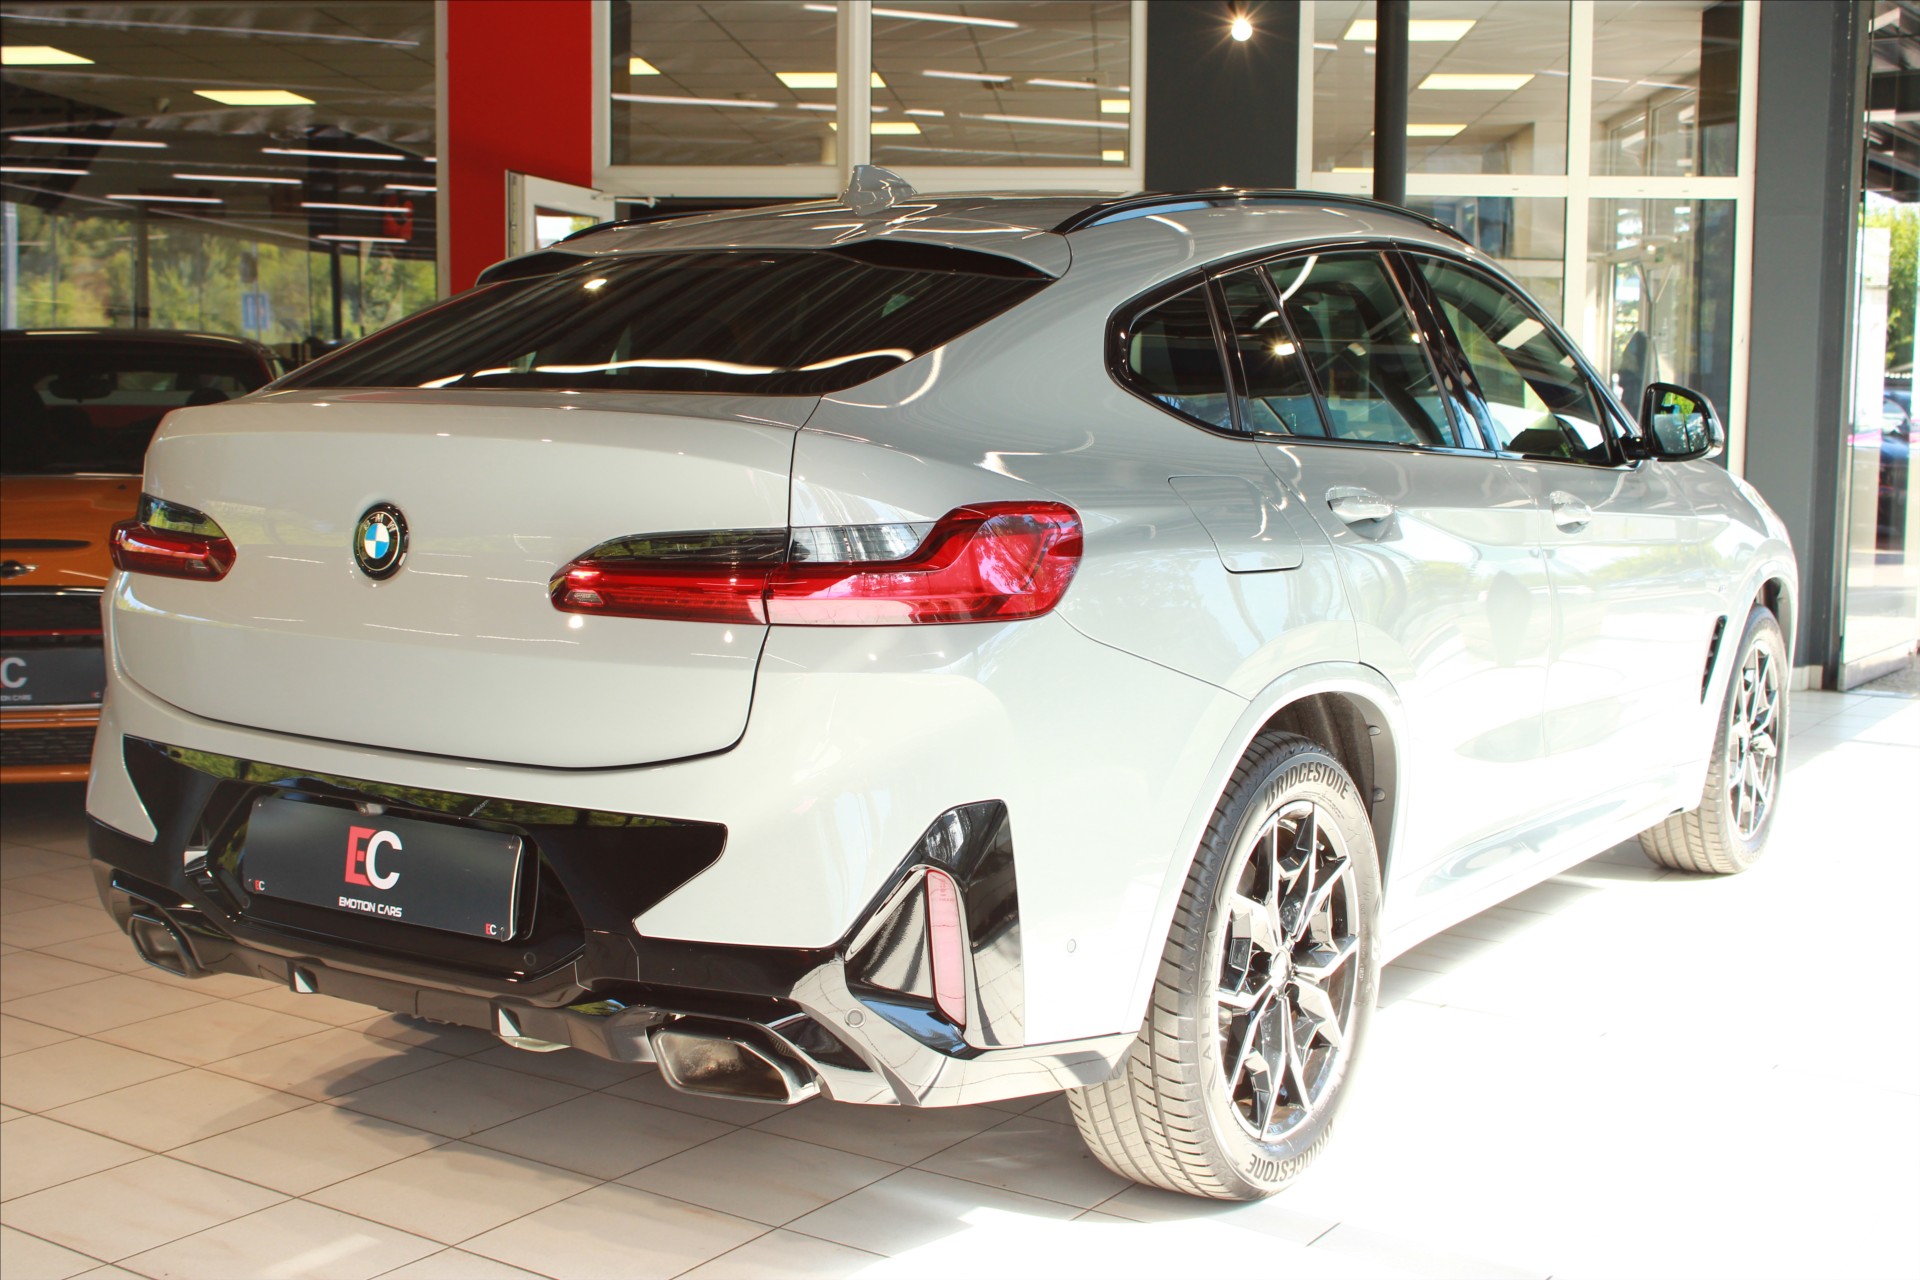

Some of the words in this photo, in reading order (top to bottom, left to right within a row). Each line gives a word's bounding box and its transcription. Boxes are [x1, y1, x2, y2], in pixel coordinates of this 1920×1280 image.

[0, 657, 27, 689] C
[1264, 762, 1350, 812] BRIDGESTONE
[345, 825, 403, 890] EC
[255, 880, 265, 891] EC
[339, 896, 376, 913] EMOTION
[377, 904, 402, 918] CARS
[485, 923, 497, 935] EC
[1201, 930, 1217, 1061] ALENZA
